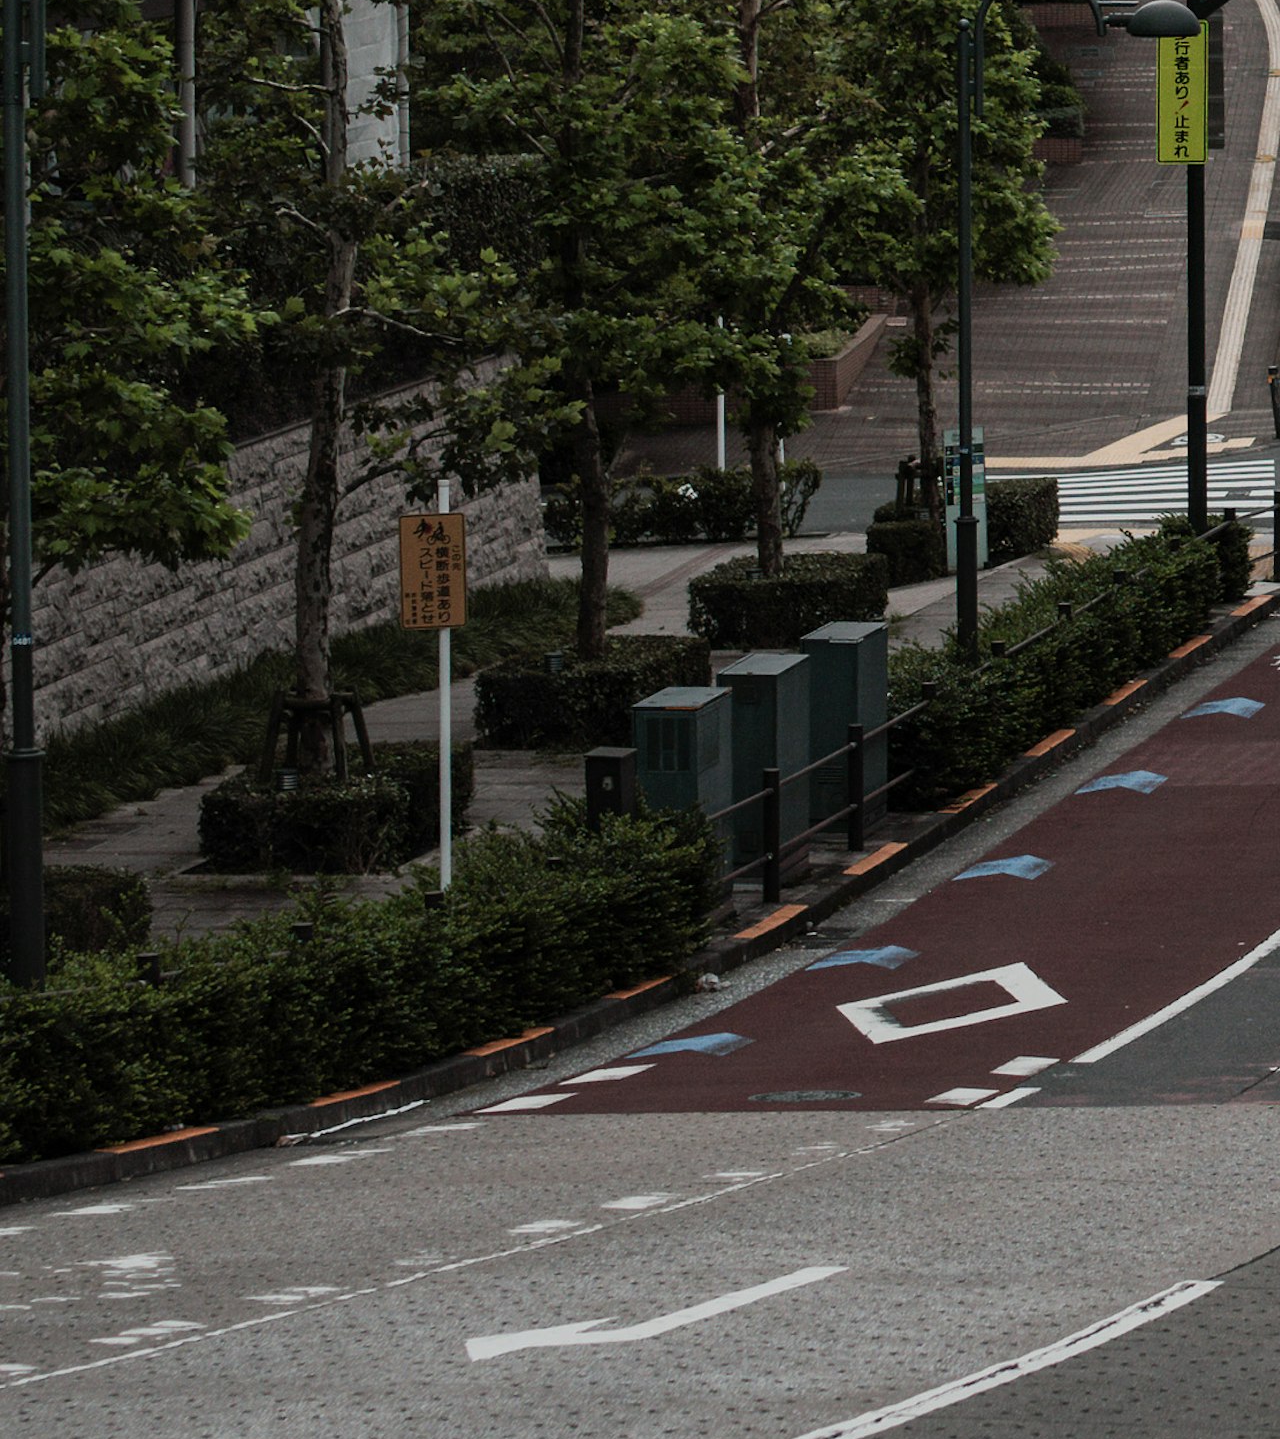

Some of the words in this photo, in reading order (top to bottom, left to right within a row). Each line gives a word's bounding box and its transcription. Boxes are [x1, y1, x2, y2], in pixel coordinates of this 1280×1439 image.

[1174, 35, 1190, 158] 行者あり！止まれ
[420, 547, 435, 624] スピード落とせ
[435, 547, 451, 623] 横断歩道あり
